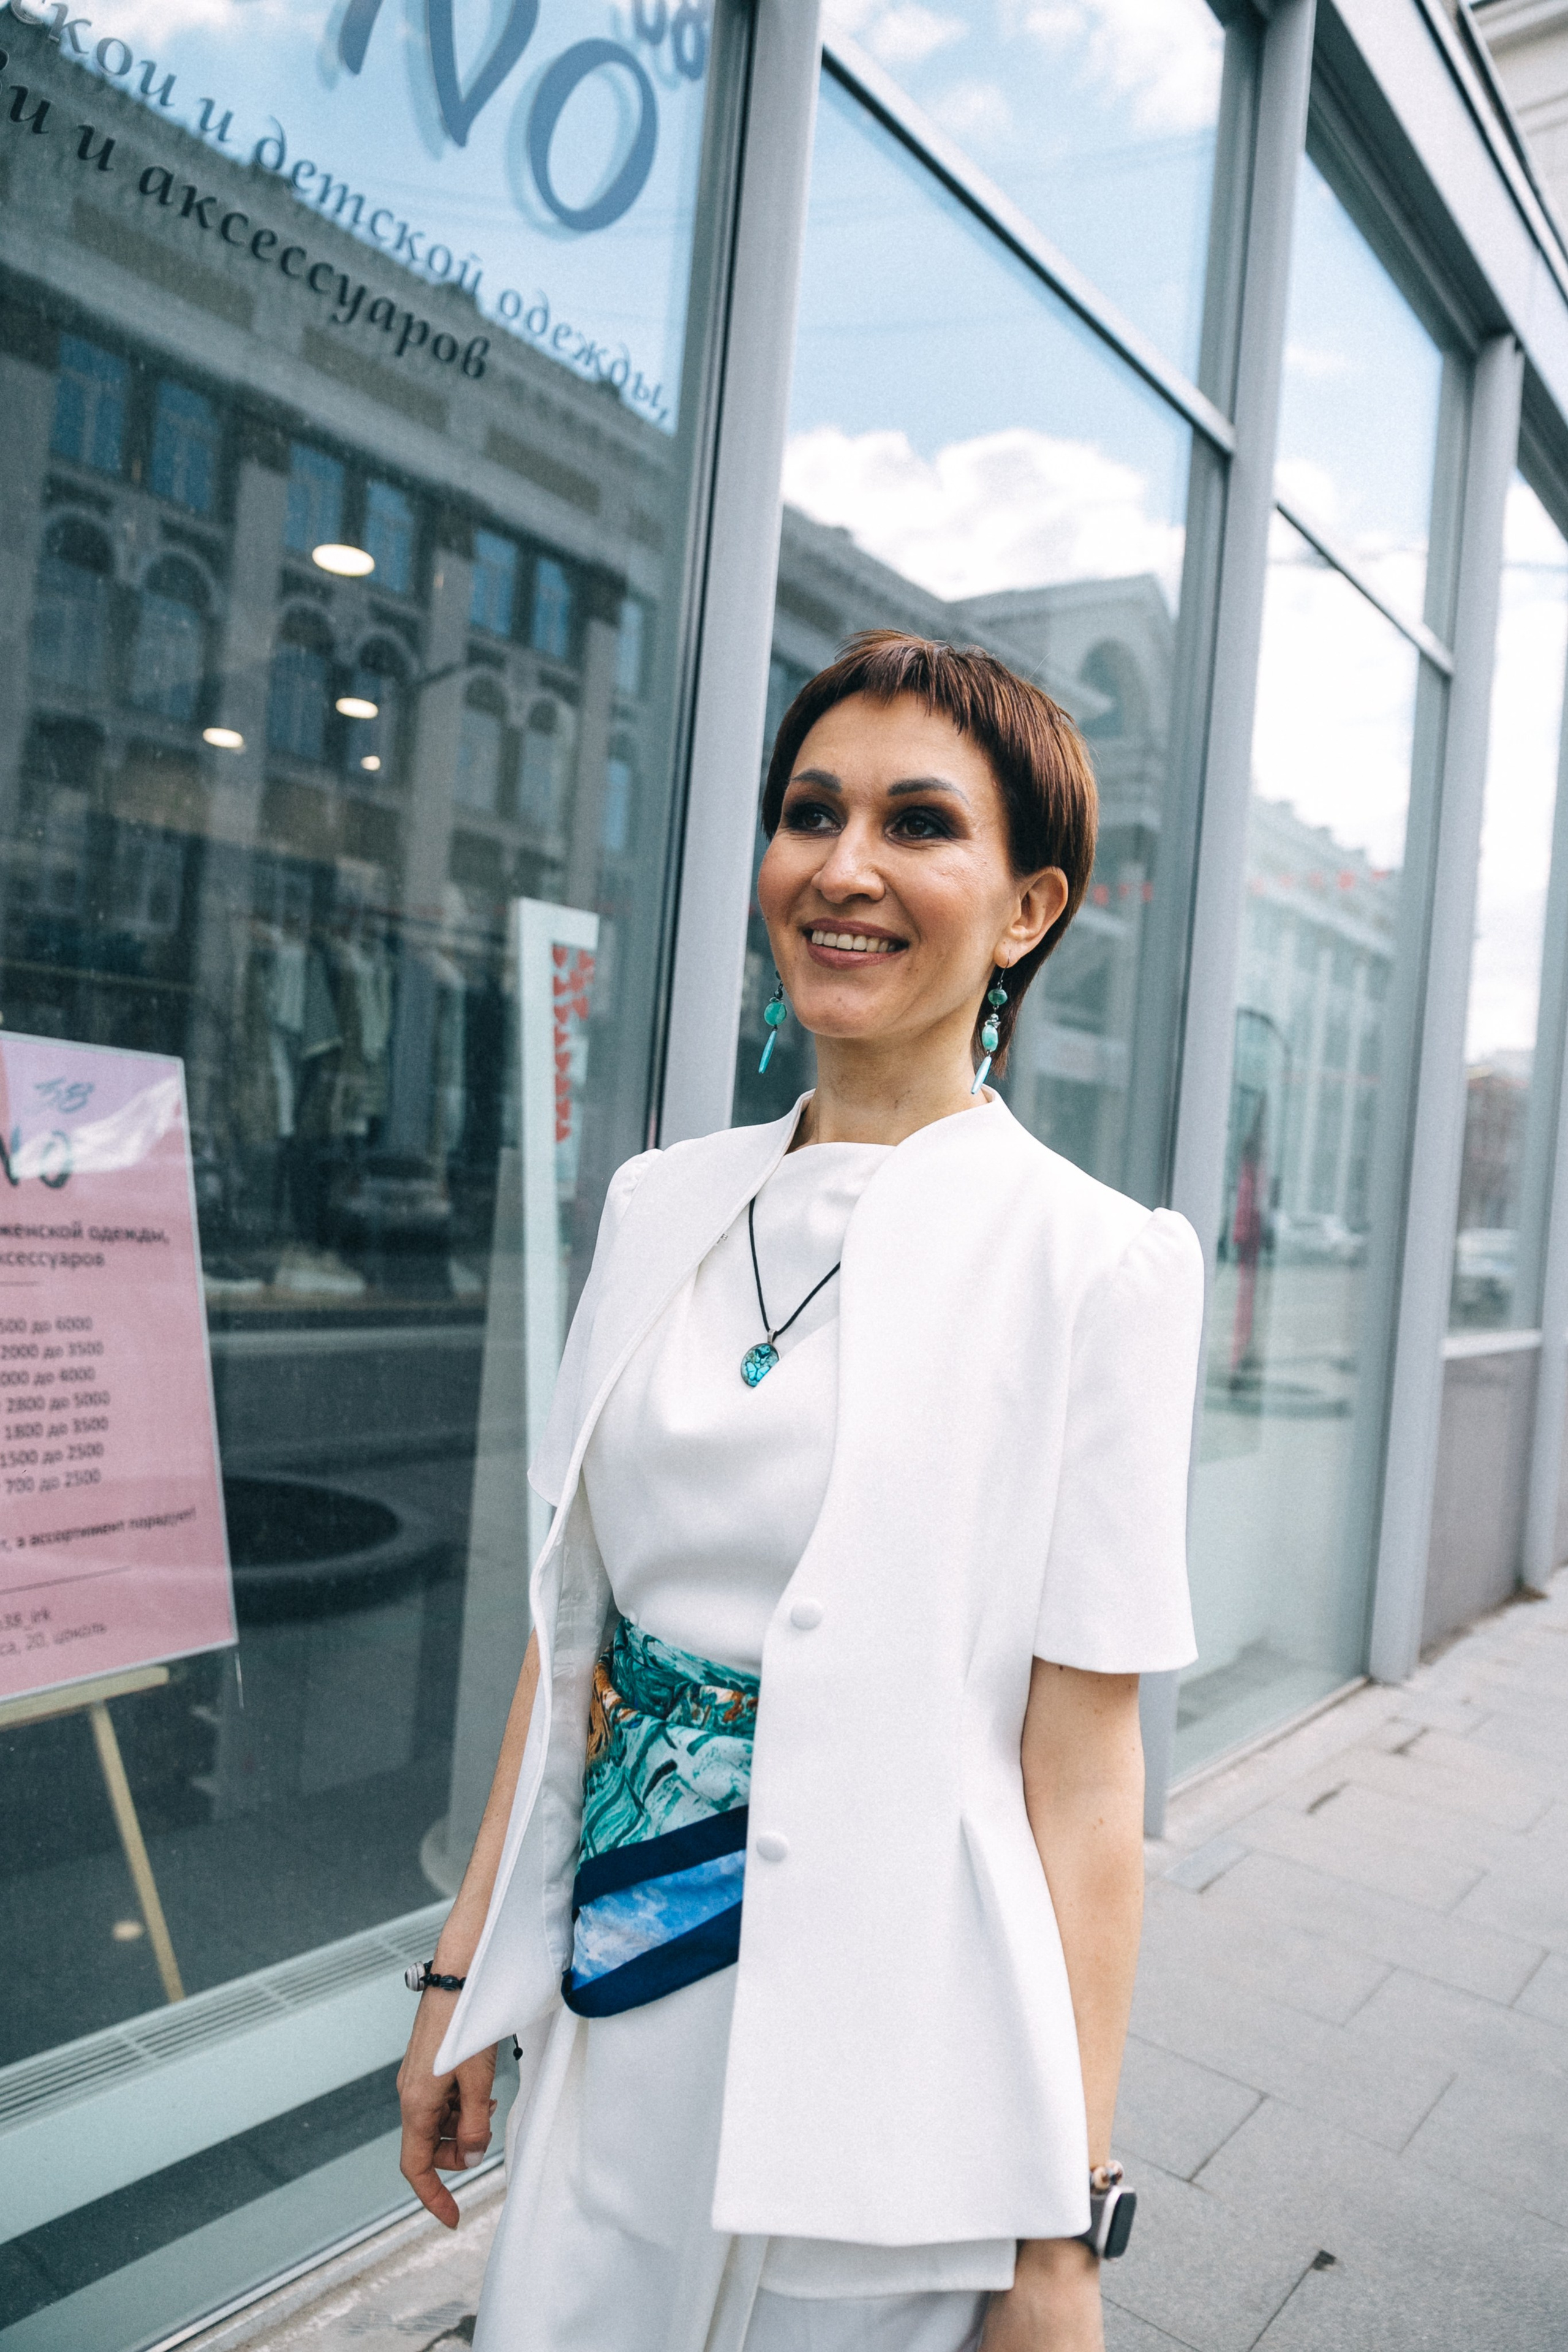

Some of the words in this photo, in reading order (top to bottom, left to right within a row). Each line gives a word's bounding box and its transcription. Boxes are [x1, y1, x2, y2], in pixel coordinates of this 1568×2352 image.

[76, 124, 116, 172] и
[138, 165, 489, 380] аксессуаров
[199, 97, 234, 142] и
[255, 115, 483, 295] детской
